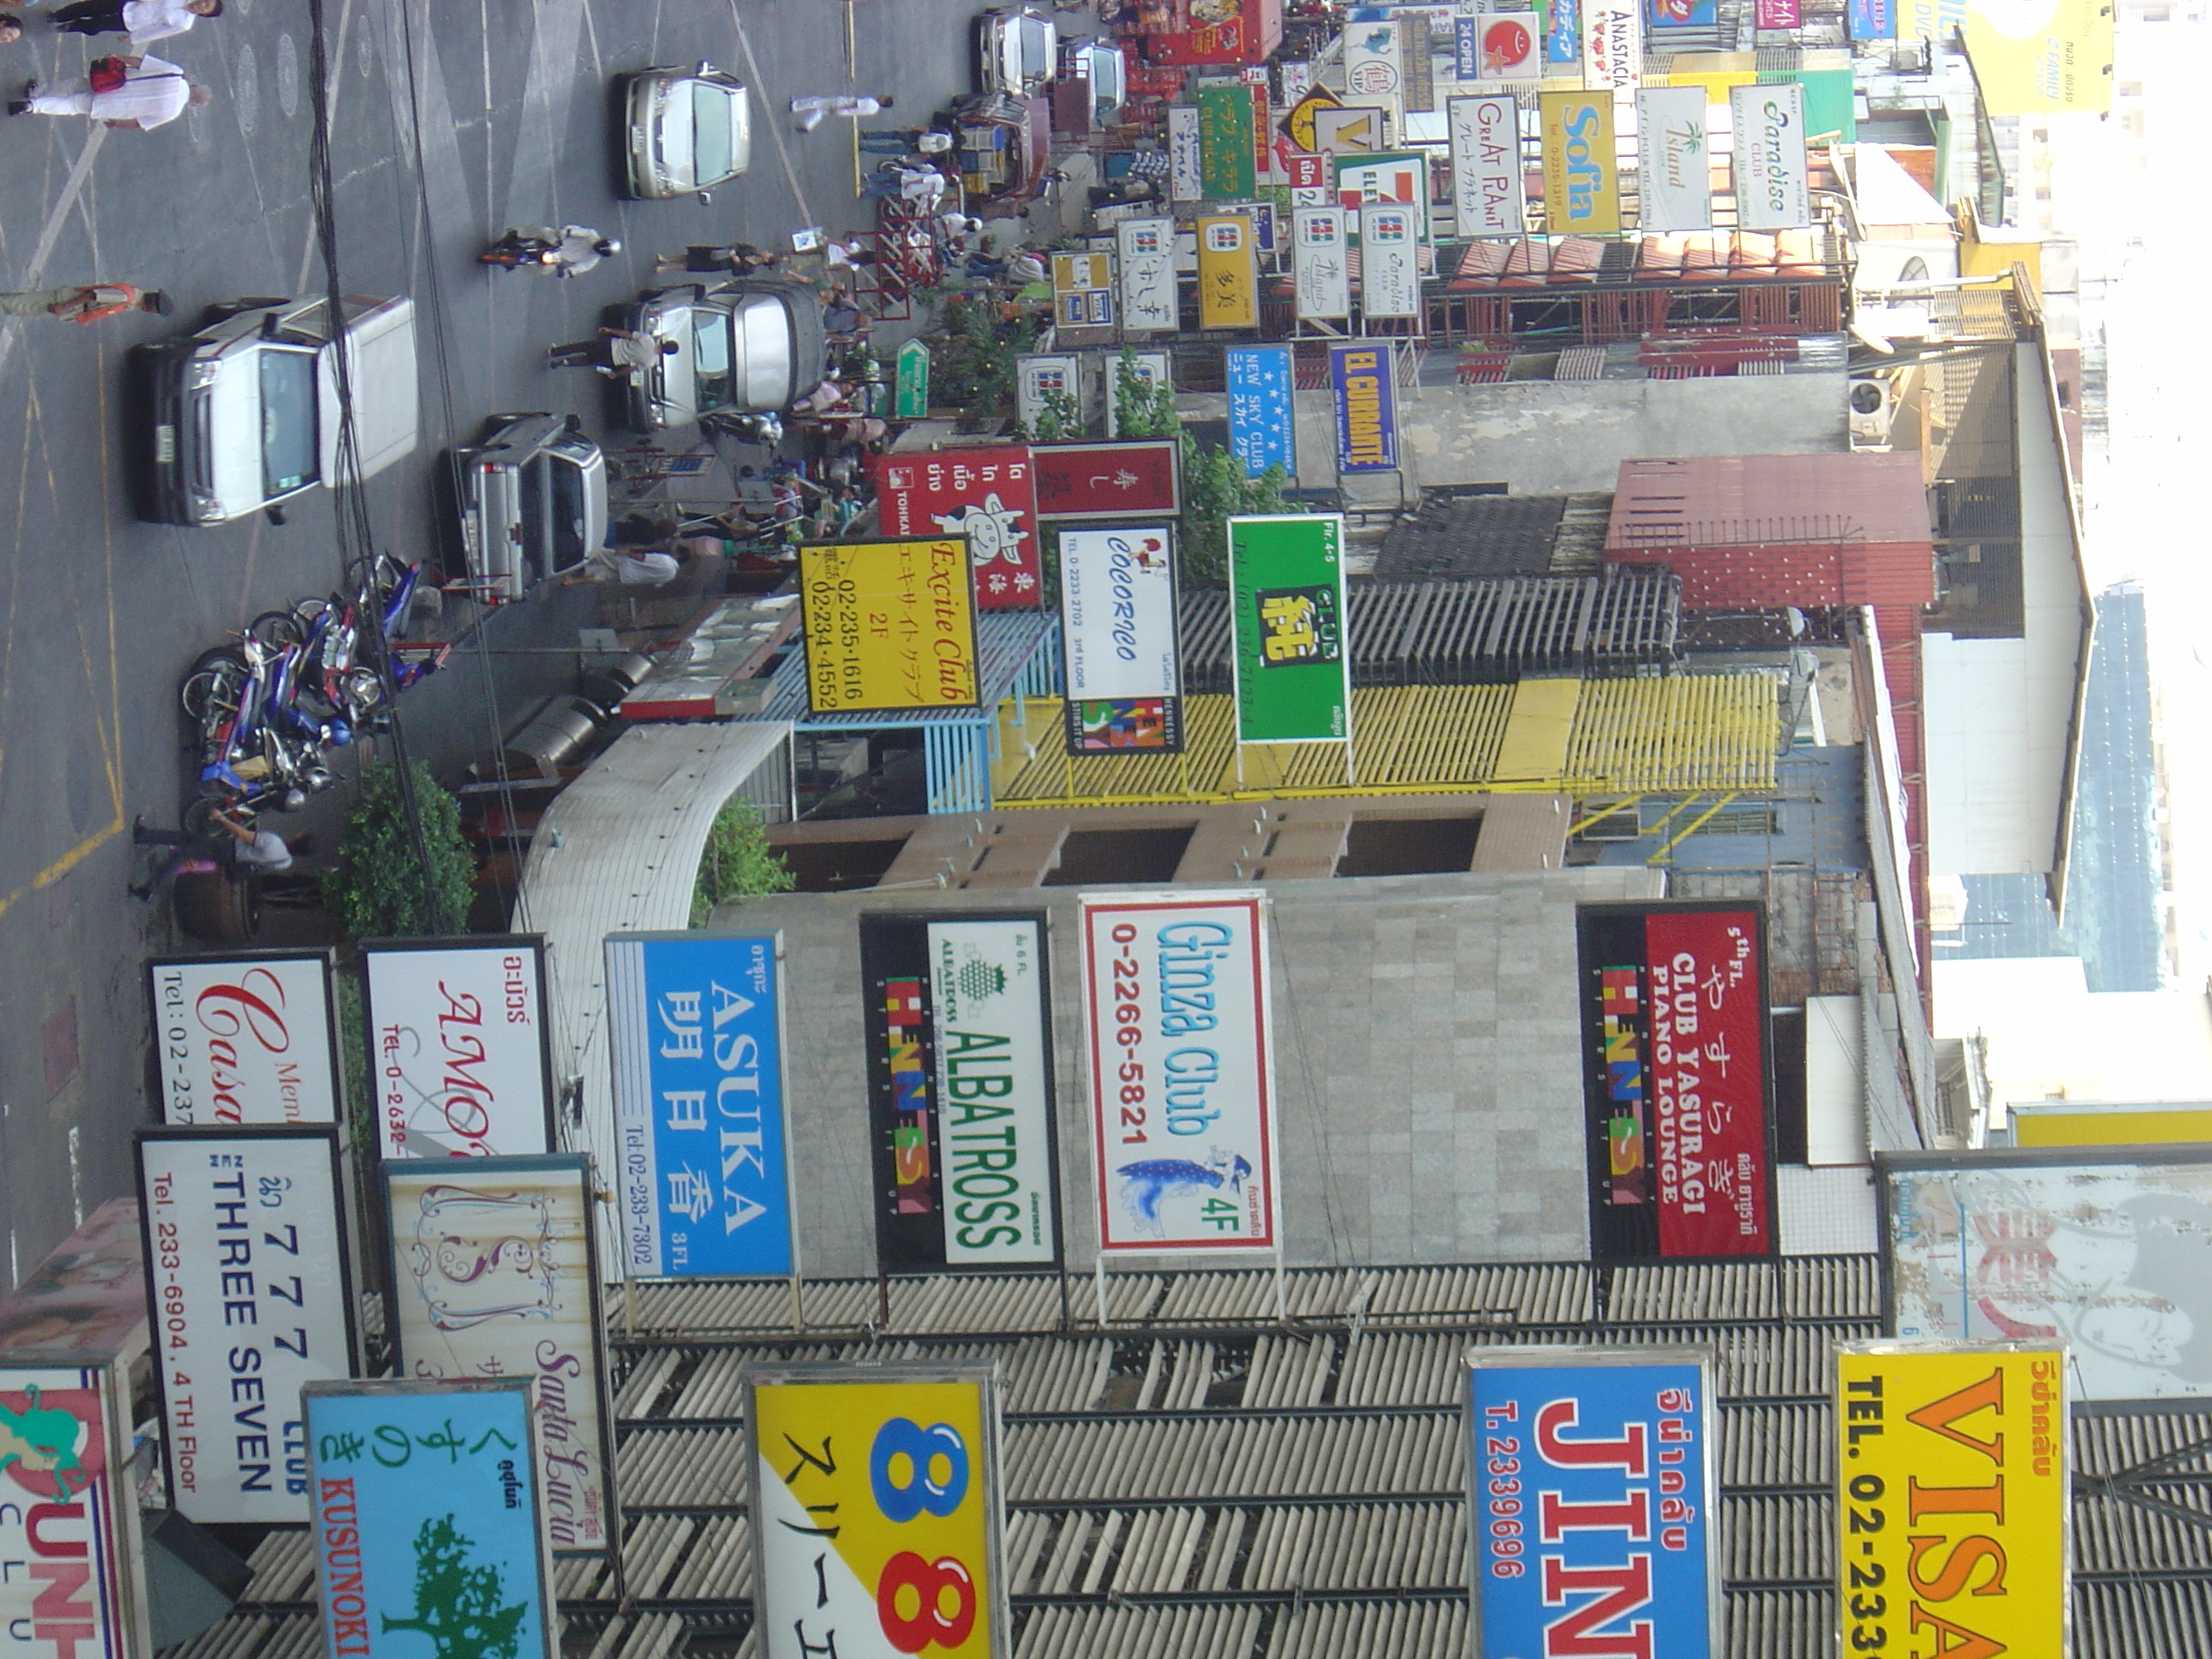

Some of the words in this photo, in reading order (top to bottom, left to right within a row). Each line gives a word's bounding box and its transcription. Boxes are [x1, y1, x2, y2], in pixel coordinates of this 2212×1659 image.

[1459, 23, 1472, 37] 24
[1460, 39, 1473, 74] OPEN
[1353, 71, 1363, 90] VIP
[1202, 107, 1214, 136] CLUB
[1300, 160, 1316, 185] เปิด
[1563, 104, 1603, 220] Sofia
[1666, 129, 1691, 189] Island
[1750, 143, 1762, 177] CLUB
[1763, 101, 1790, 211] Paradise
[1246, 354, 1262, 386] NEW
[1345, 352, 1377, 374] EL
[1233, 393, 1248, 427] スカイ
[1249, 395, 1265, 425] SKY
[1250, 432, 1265, 469] CLUB
[1324, 521, 1335, 541] Flr.
[1324, 543, 1336, 562] 4-5
[897, 544, 919, 642] エキサイト
[927, 543, 959, 632] Excite
[1107, 537, 1137, 661] COCORICO
[869, 613, 888, 639] 2F
[1315, 589, 1339, 660] CLUB
[899, 649, 924, 703] クラブ
[933, 638, 968, 700] Club
[1074, 656, 1085, 689] FLOOR
[1072, 702, 1081, 727] STIRS
[1074, 738, 1083, 749] UP
[1164, 698, 1174, 746] HENNESSY
[941, 939, 958, 1022] ALBATROSS
[1156, 921, 1234, 1037] Ginza
[1672, 952, 1697, 1035] CLUB
[382, 1024, 399, 1058] TEL.
[1111, 923, 1149, 1145] 0-2266-5821
[1652, 965, 1673, 1065] PIANO
[195, 969, 289, 1125] Casa
[656, 991, 714, 1225] 明日香
[711, 980, 768, 1237] ASUKA
[1164, 1047, 1221, 1137] Club
[1701, 964, 1734, 1200] やすらぎ
[945, 1031, 1022, 1249] ALBATROSS
[1657, 1077, 1678, 1204] LOUNGE
[1676, 1047, 1706, 1214] YASURAGI
[154, 1172, 174, 1215] Tel.
[1201, 1197, 1240, 1232] 4F
[212, 1172, 258, 1326] THREE
[175, 1395, 195, 1428] TH
[229, 1347, 273, 1493] SEVEN
[534, 1340, 580, 1442] Santa
[1487, 1400, 1517, 1429] T.
[1848, 1376, 1883, 1459] TEL.
[178, 1436, 198, 1493] Floor
[319, 1419, 517, 1469] くすのき
[543, 1445, 589, 1545] Lucia
[1487, 1437, 1524, 1579] 2339696
[320, 1477, 370, 1658] KUSUNOKI
[1848, 1476, 1888, 1659] 02-233
